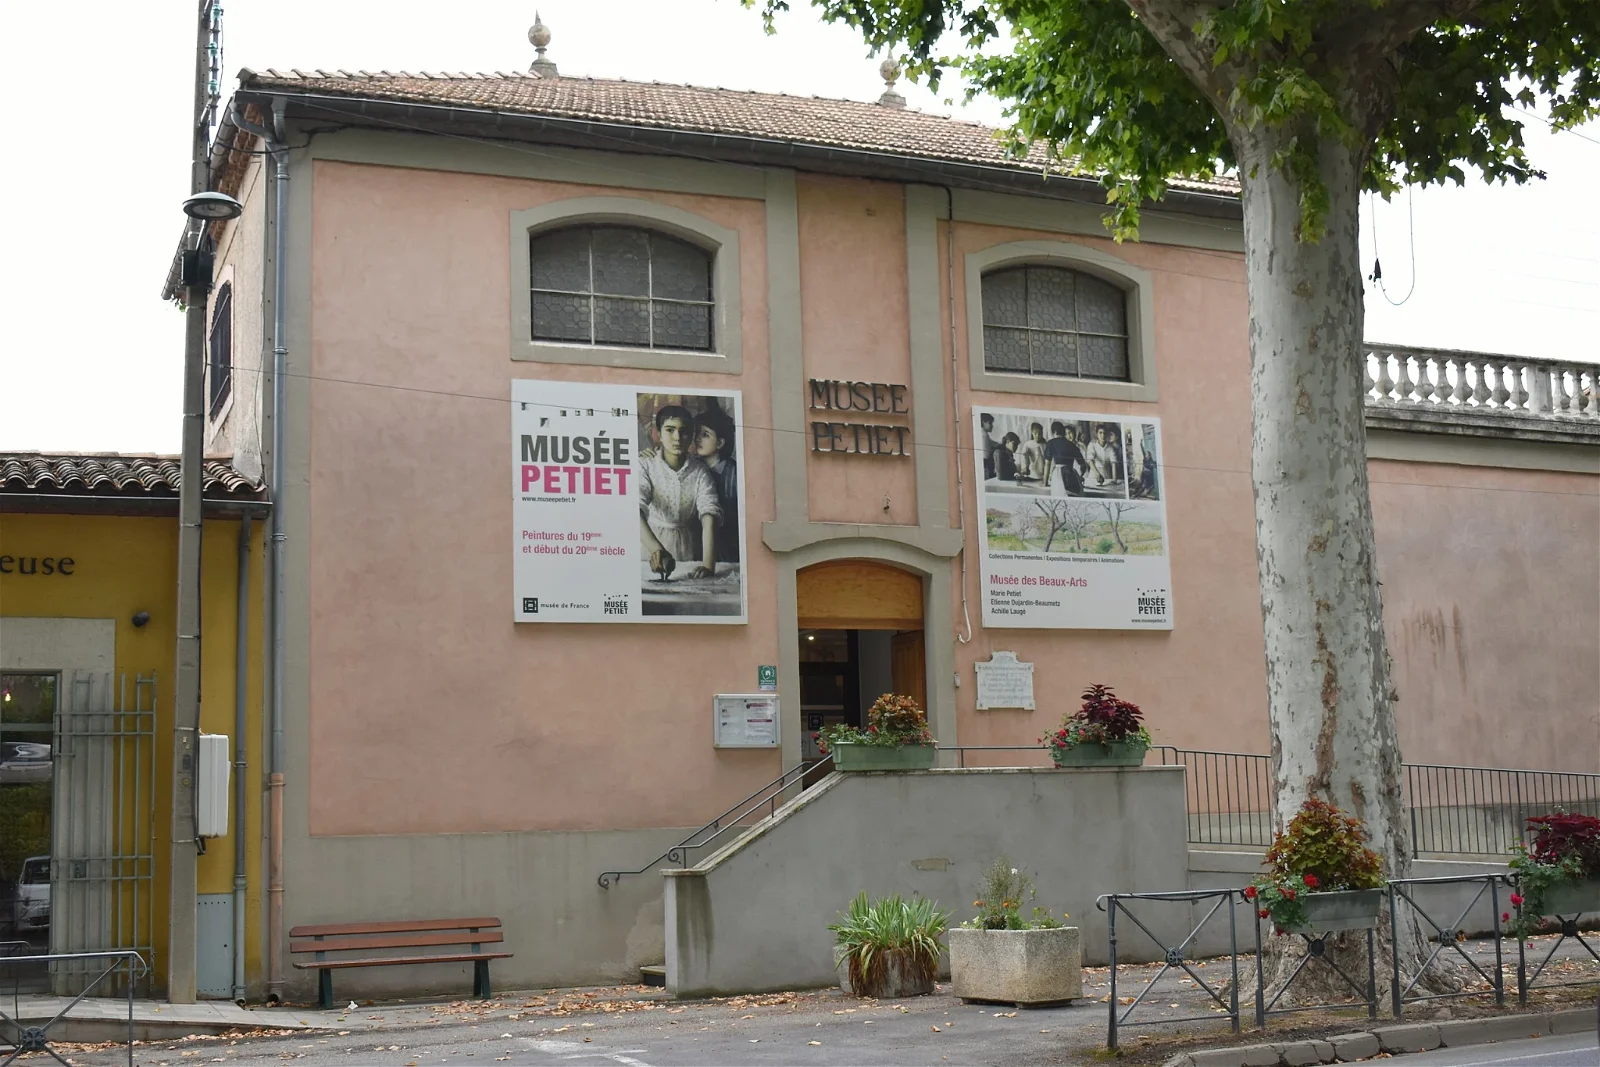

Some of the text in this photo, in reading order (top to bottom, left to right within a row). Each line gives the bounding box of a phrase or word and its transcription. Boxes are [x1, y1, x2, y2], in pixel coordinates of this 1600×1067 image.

[809, 379, 909, 414] MUSEE
[811, 421, 911, 456] PETIET
[521, 430, 630, 465] MUSÉE
[521, 465, 631, 495] PETIET
[522, 530, 565, 541] Peintures
[567, 532, 579, 541] du
[522, 544, 532, 554] et
[534, 544, 560, 554] début
[562, 545, 574, 555] du
[599, 546, 626, 556] siècle
[990, 574, 1088, 588] Musée des Beaux-Arts
[604, 600, 628, 608] MUSÉE
[1138, 596, 1166, 606] MUSÉE
[1138, 606, 1166, 615] PETIET
